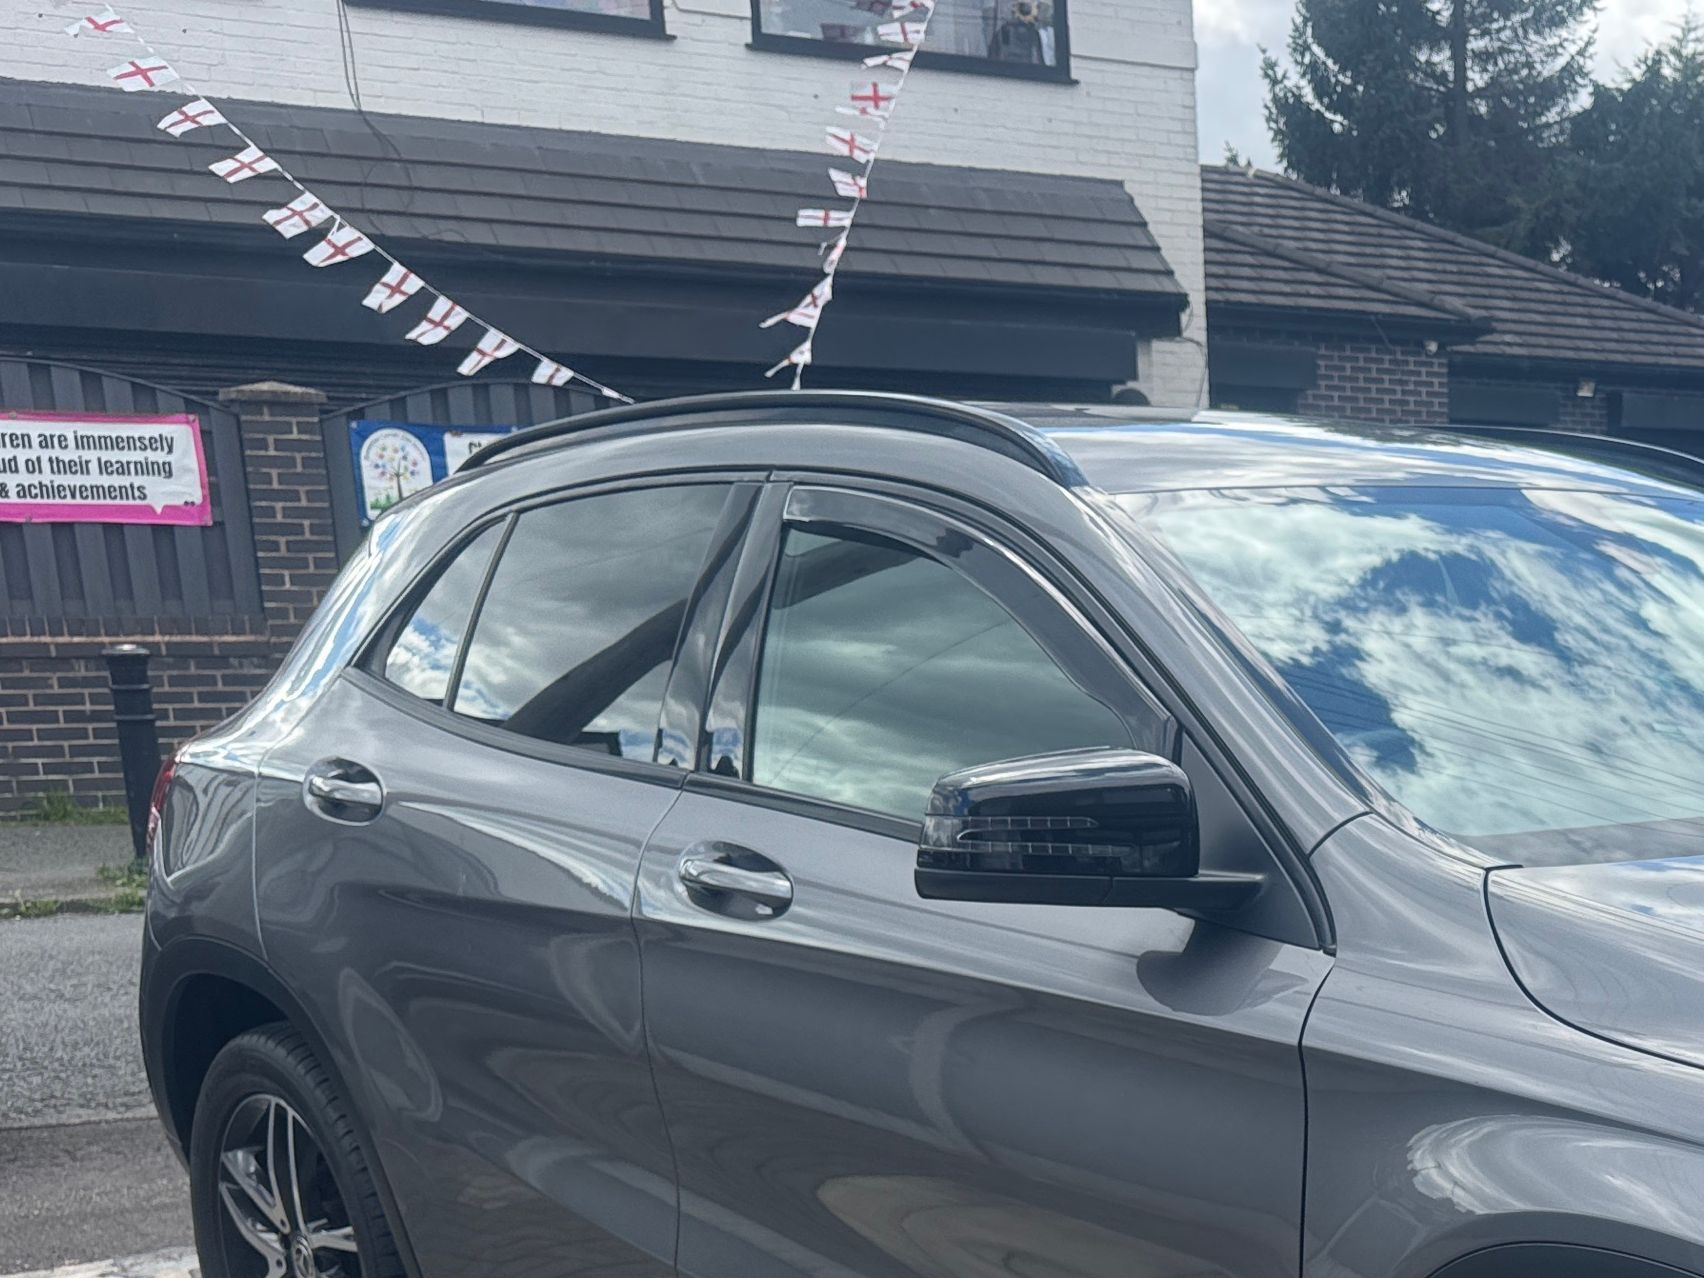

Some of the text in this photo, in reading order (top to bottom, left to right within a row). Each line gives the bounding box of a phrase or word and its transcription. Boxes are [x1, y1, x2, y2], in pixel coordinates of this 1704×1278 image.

[37, 433, 69, 451] are
[73, 430, 174, 455] immensely
[24, 455, 43, 475] of
[48, 455, 91, 476] their
[97, 456, 173, 479] learning
[16, 480, 148, 501] achievements
